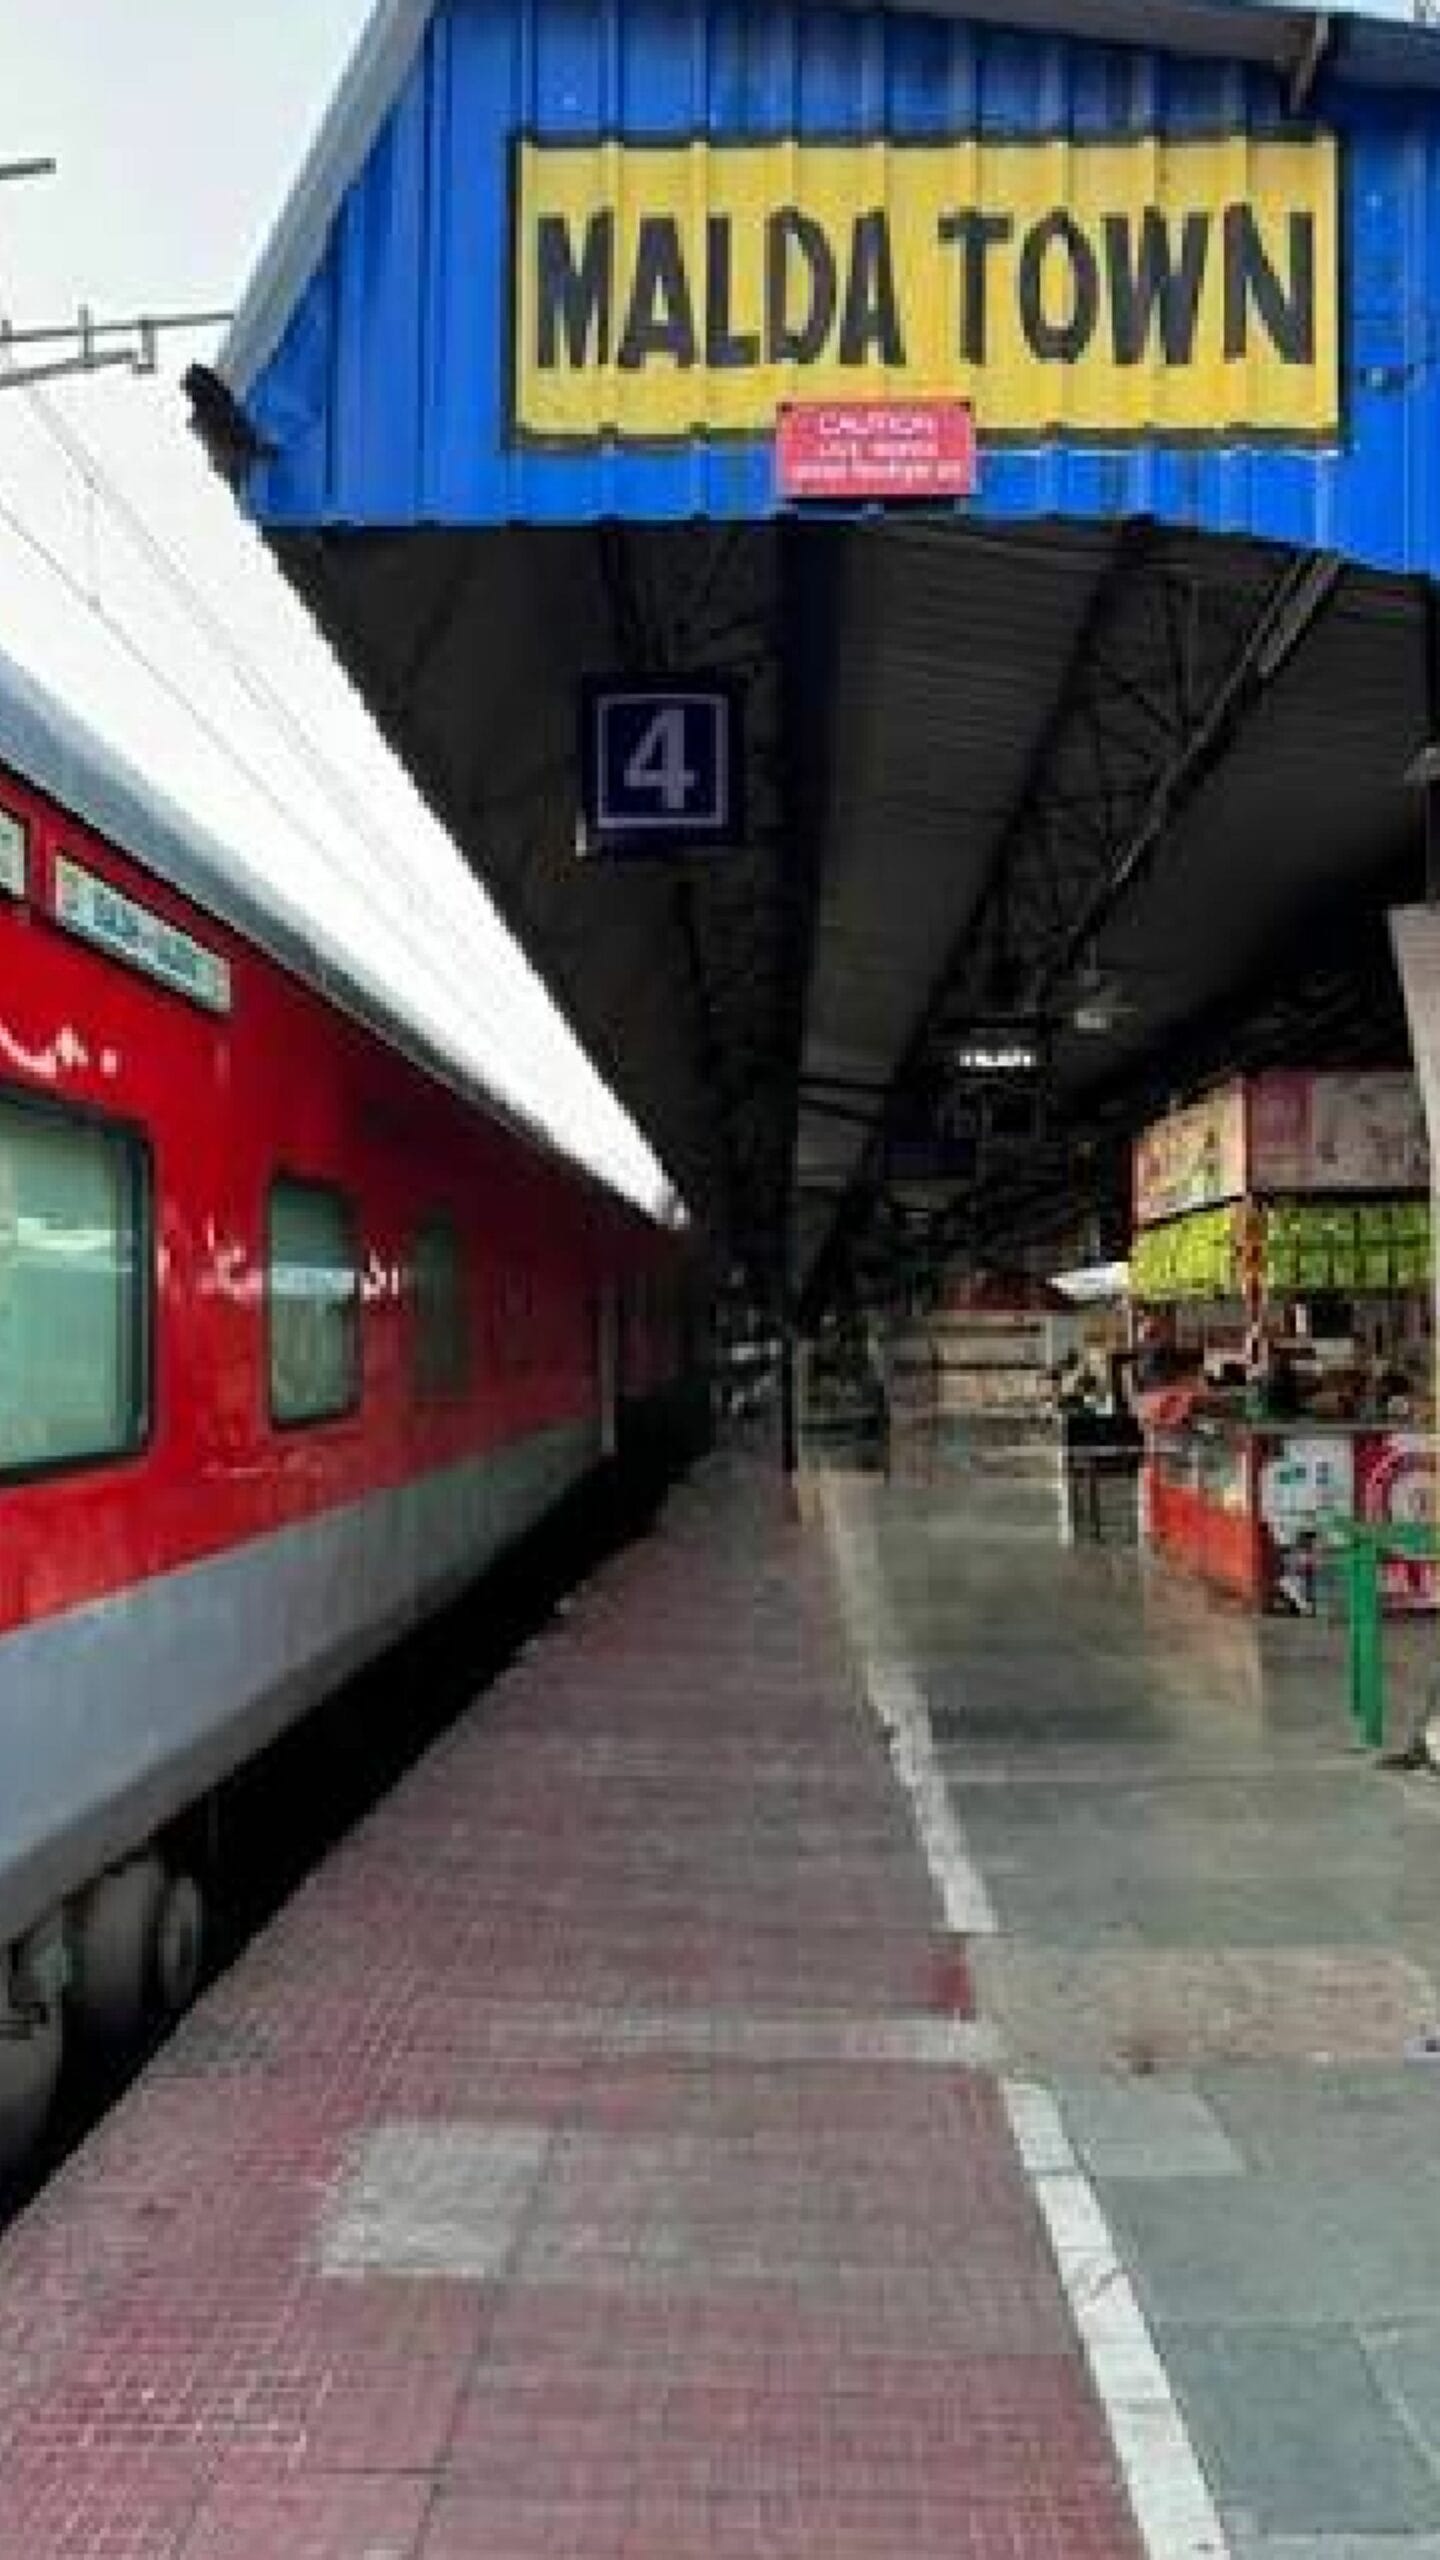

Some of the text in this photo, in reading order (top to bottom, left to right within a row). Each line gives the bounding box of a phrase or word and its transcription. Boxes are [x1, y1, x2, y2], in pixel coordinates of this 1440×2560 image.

[535, 204, 1316, 369] MALDA TOWN
[819, 411, 934, 435] CAUTION
[623, 709, 695, 809] 4
